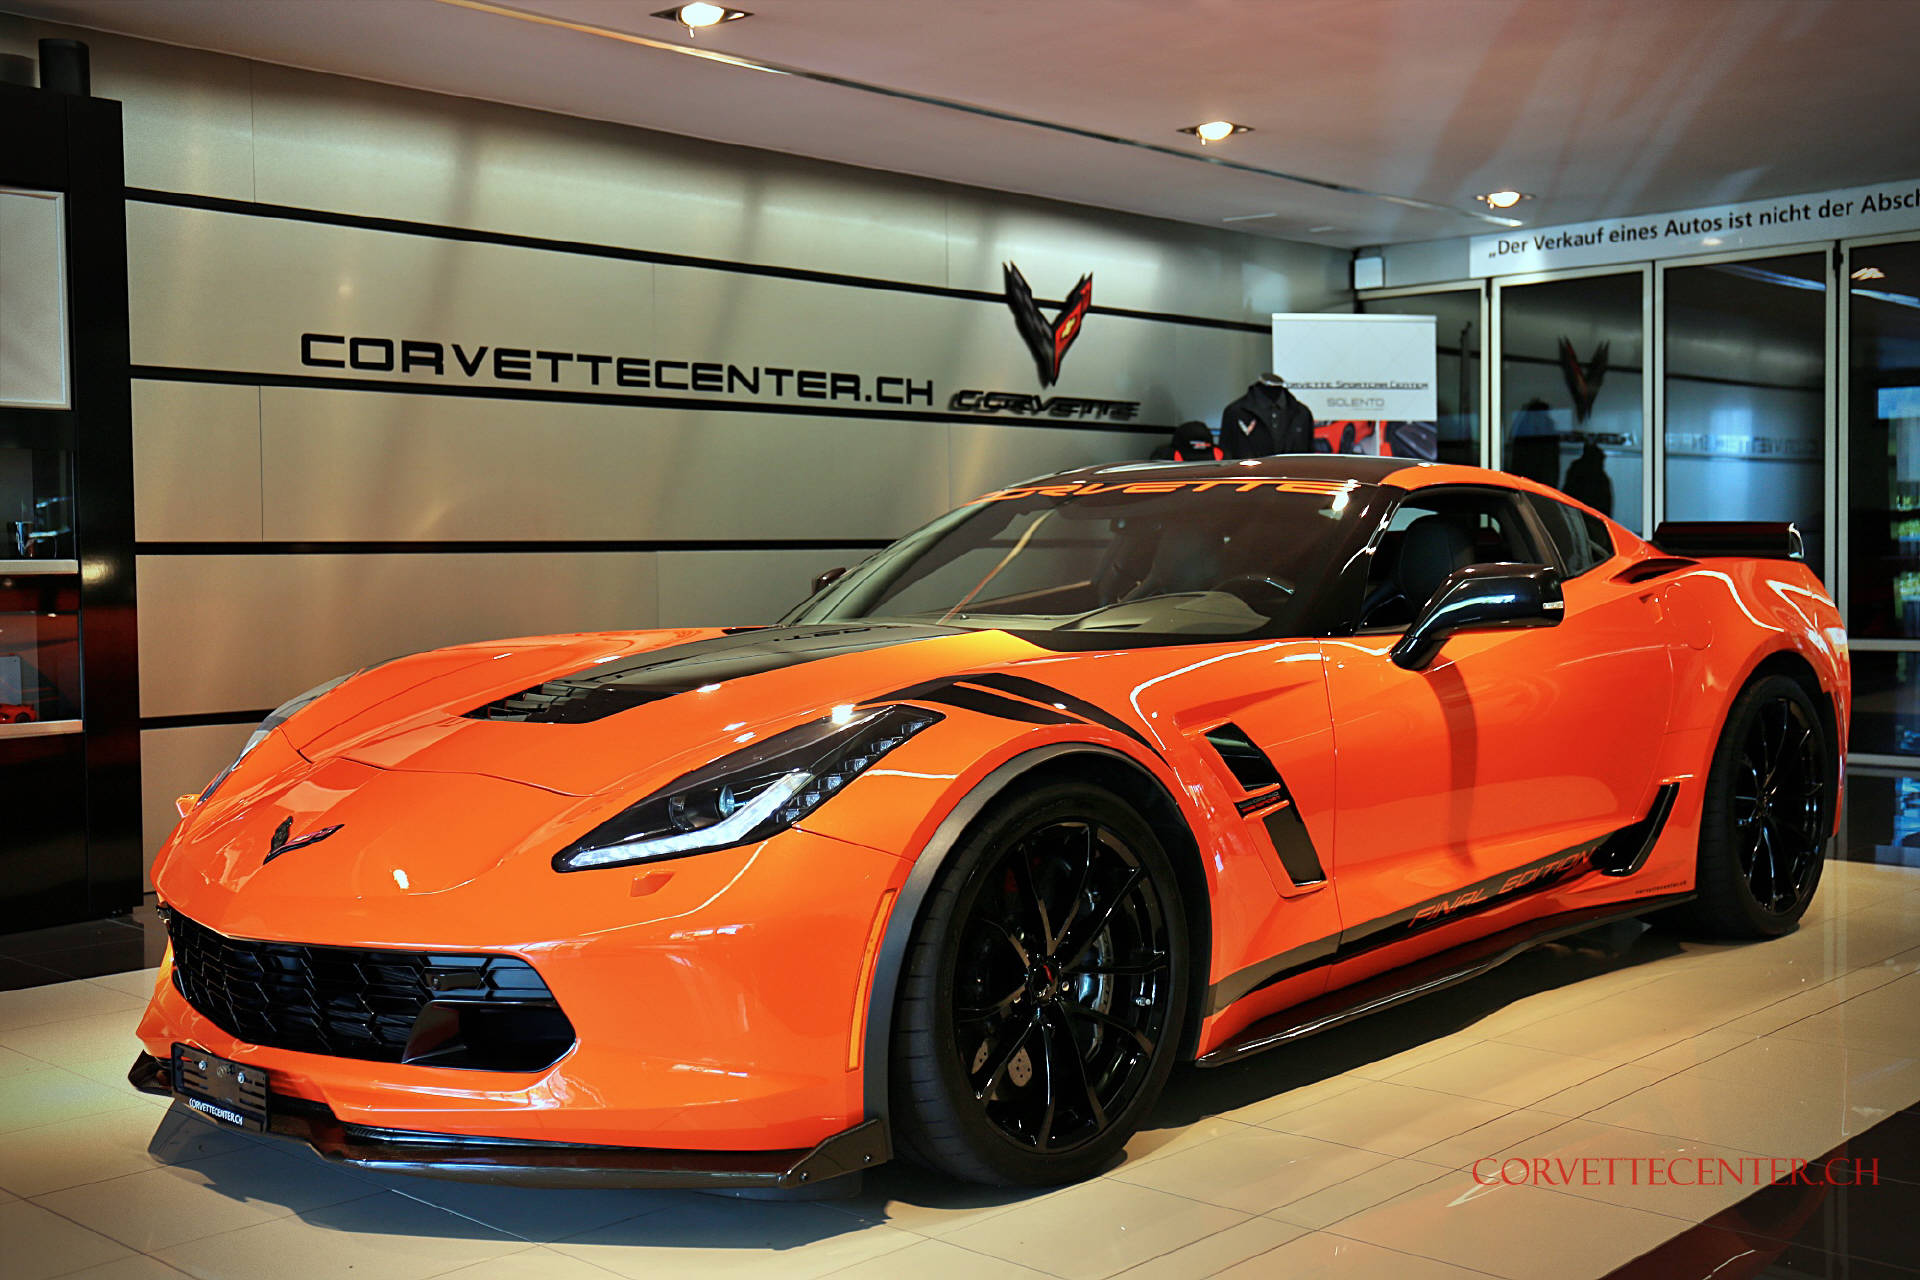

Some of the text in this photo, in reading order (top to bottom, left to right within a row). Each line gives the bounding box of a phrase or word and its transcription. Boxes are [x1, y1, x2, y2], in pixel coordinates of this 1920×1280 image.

[1534, 228, 1604, 250] Verkauf
[1609, 225, 1658, 244] eines
[1664, 217, 1723, 237] Autos
[1729, 212, 1752, 229] ist
[1759, 204, 1811, 225] nicht
[1818, 200, 1853, 218] der
[301, 332, 933, 406] CORVETTECENTER.CH
[949, 389, 1141, 420] CORVETTE
[1408, 846, 1597, 928] FINAL EDITION
[188, 1097, 244, 1126] CORVETTECENTER.CH
